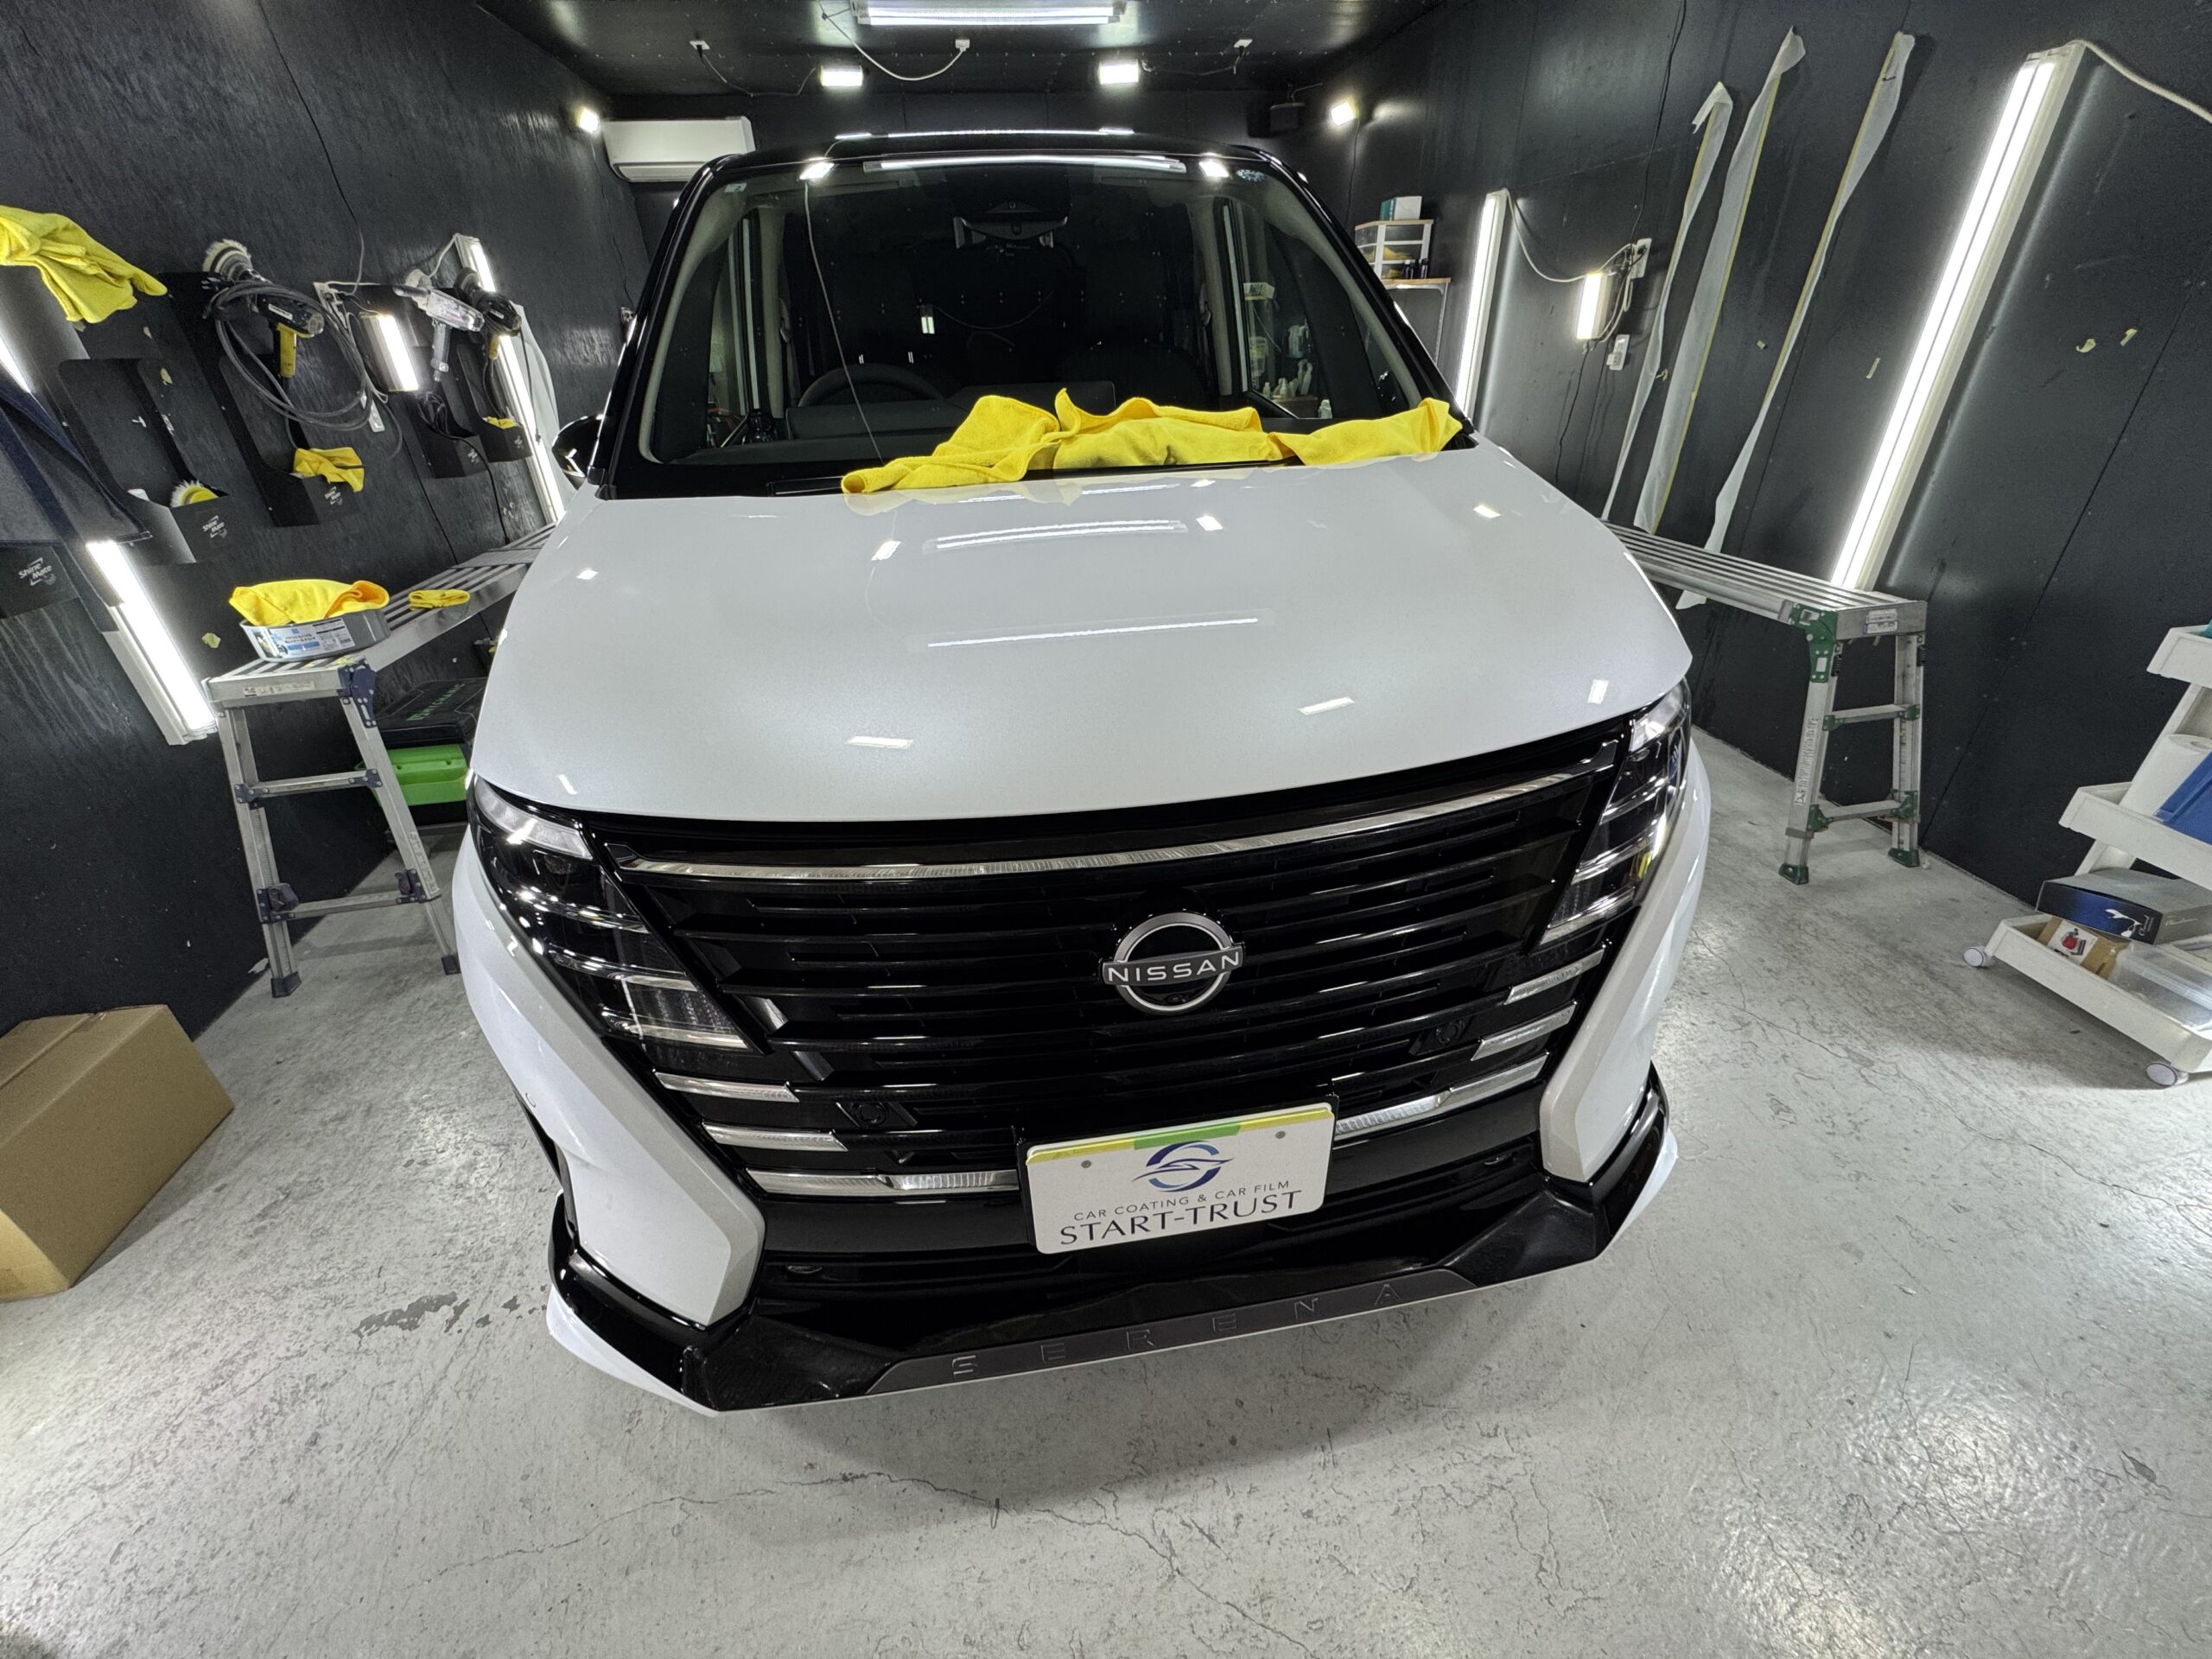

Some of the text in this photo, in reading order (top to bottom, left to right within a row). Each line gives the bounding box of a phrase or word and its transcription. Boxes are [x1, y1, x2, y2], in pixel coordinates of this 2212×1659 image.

[18, 563, 41, 579] Shine
[1108, 951, 1239, 982] NISSAN
[1059, 1190, 1302, 1245] START-TRUST
[1073, 1180, 1290, 1222] CAR COATING & CAR FILM
[951, 1283, 1404, 1379] SERENA
